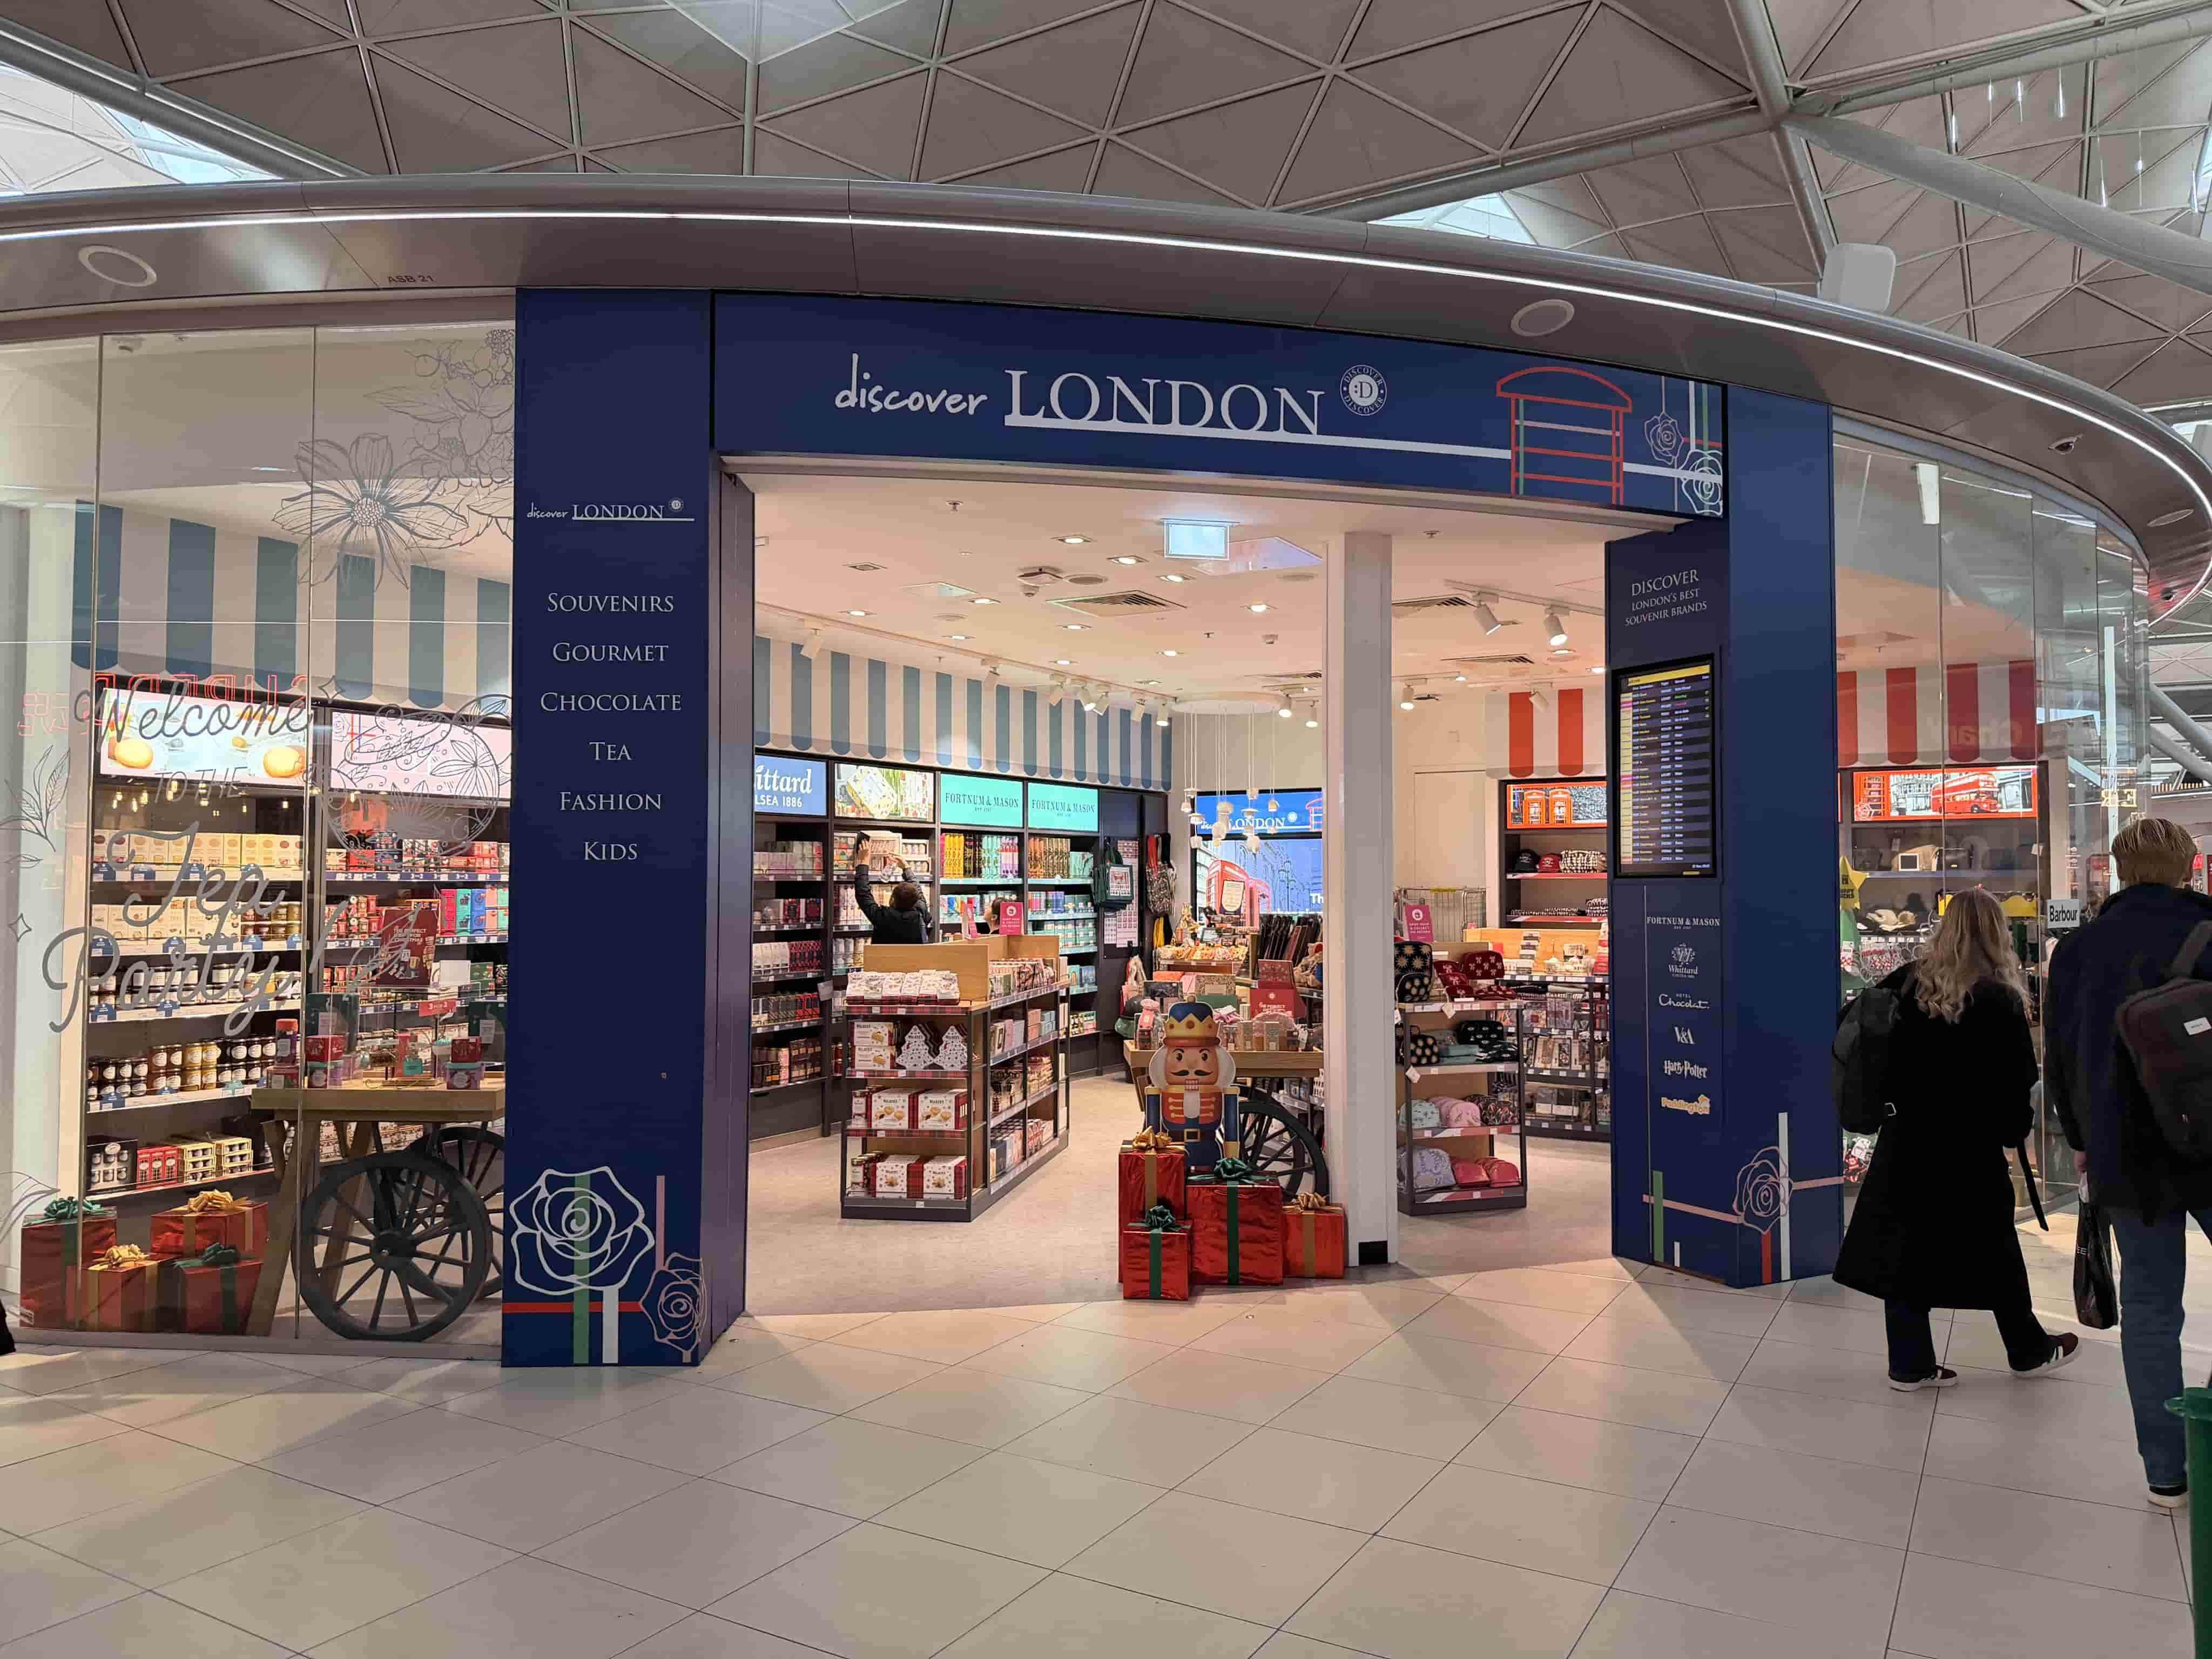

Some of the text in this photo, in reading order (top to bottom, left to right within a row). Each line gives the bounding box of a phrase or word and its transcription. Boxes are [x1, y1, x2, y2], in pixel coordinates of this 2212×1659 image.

[387, 274, 434, 286] ASB 21
[1344, 367, 1382, 386] DISCOVER
[835, 353, 1325, 435] discover LONDON
[1344, 397, 1383, 414] DISCOVER
[527, 503, 665, 520] discover LONDON
[1631, 570, 1700, 596] DISCOVER
[548, 593, 674, 613] SOUVENIRS
[1632, 589, 1701, 610] LONDON'S BEST
[1625, 601, 1707, 626] SOUVENIR BRANDS
[552, 642, 669, 662] GOURMET
[540, 692, 682, 712] CHOCOLATE
[75, 682, 312, 755] Welcome
[590, 741, 631, 761] TEA
[154, 767, 248, 804] TO THE
[559, 791, 662, 811] FASHION
[783, 797, 802, 807] 1886
[946, 793, 1019, 808] FORTNUM & MASON
[1032, 800, 1065, 811] FORTNUM
[1073, 804, 1095, 813] MASON
[583, 841, 638, 860] KIDS
[107, 821, 285, 927] Tea
[1647, 916, 1683, 925] FORTNUM
[2049, 903, 2078, 922] Barbour
[1668, 965, 1698, 974] Whittard
[1674, 1027, 1695, 1044] V&A
[1664, 1060, 1708, 1078] Harry Potter
[1661, 1097, 1710, 1115] Paddington
